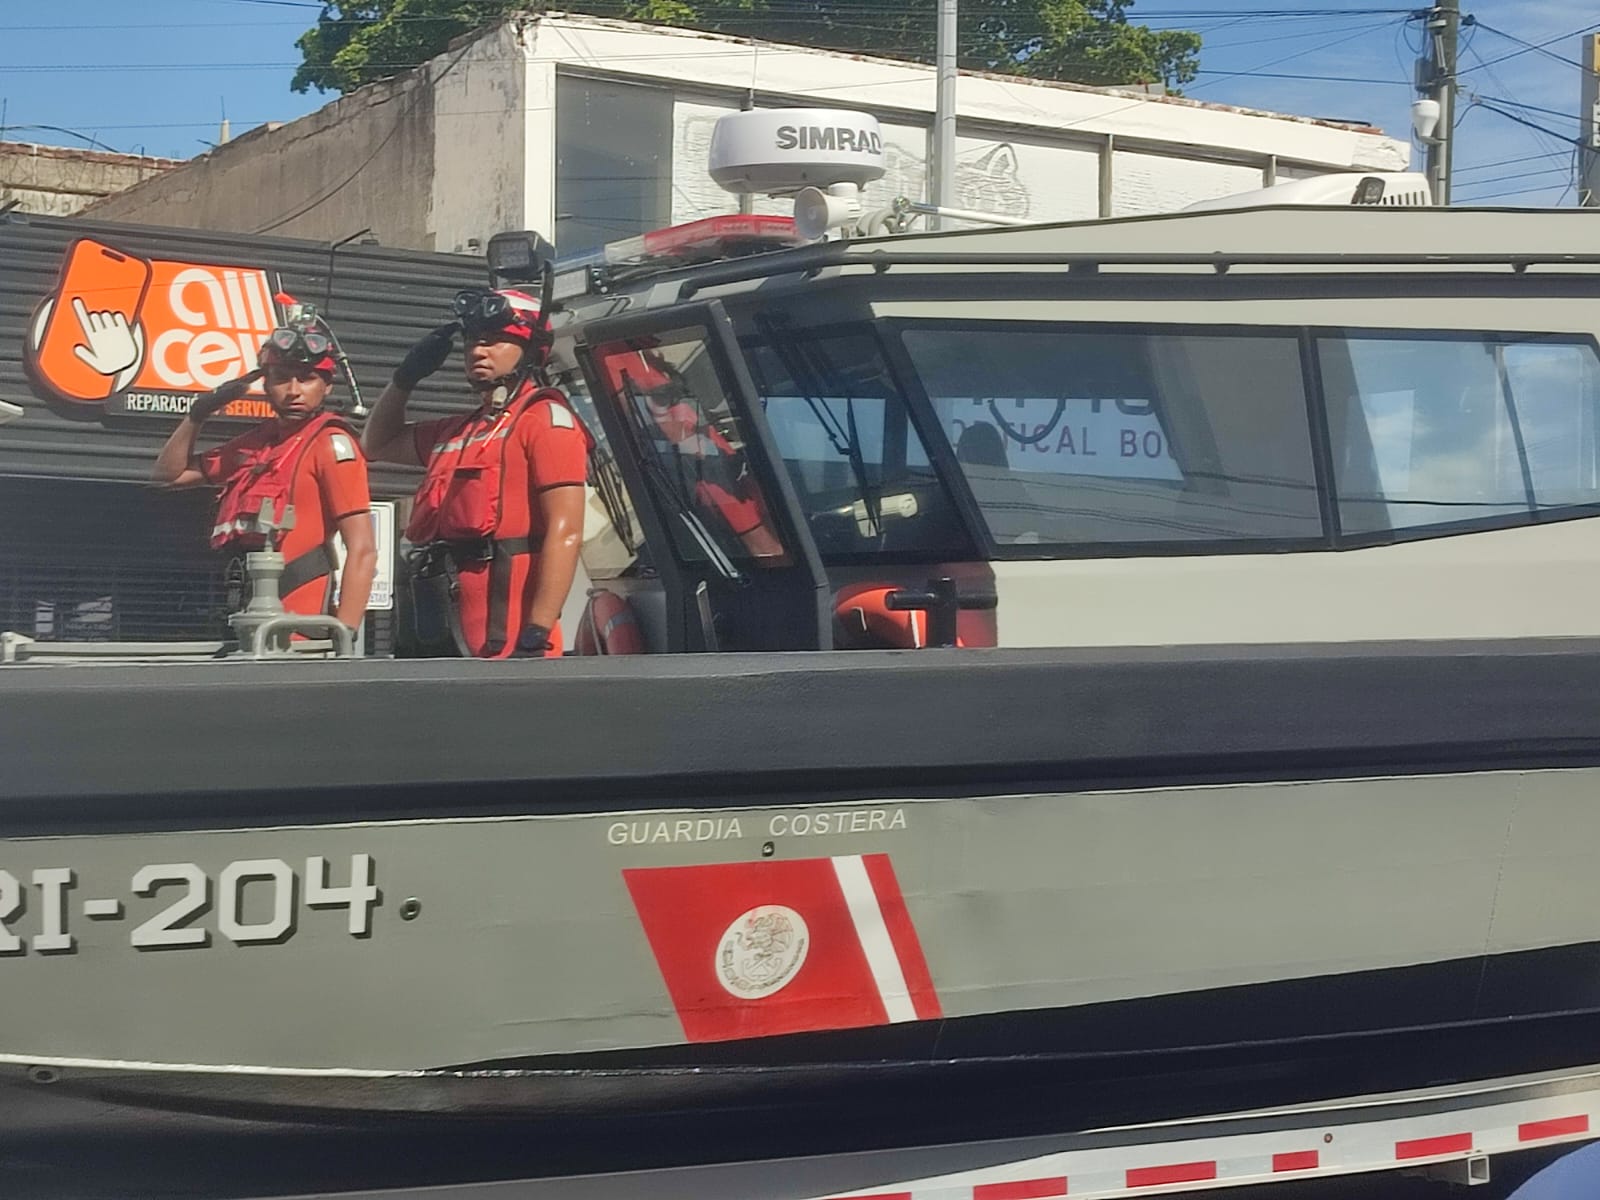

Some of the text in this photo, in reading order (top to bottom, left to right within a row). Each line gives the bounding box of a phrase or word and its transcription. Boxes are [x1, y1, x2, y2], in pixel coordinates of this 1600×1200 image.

[776, 126, 881, 155] SIMRAD
[152, 329, 271, 392] cel
[127, 393, 200, 413] REPARACI
[225, 399, 278, 418] SERVIC
[1120, 428, 1163, 459] BO
[607, 808, 907, 844] GUARDIA COSTERA
[0, 853, 380, 953] I-204
